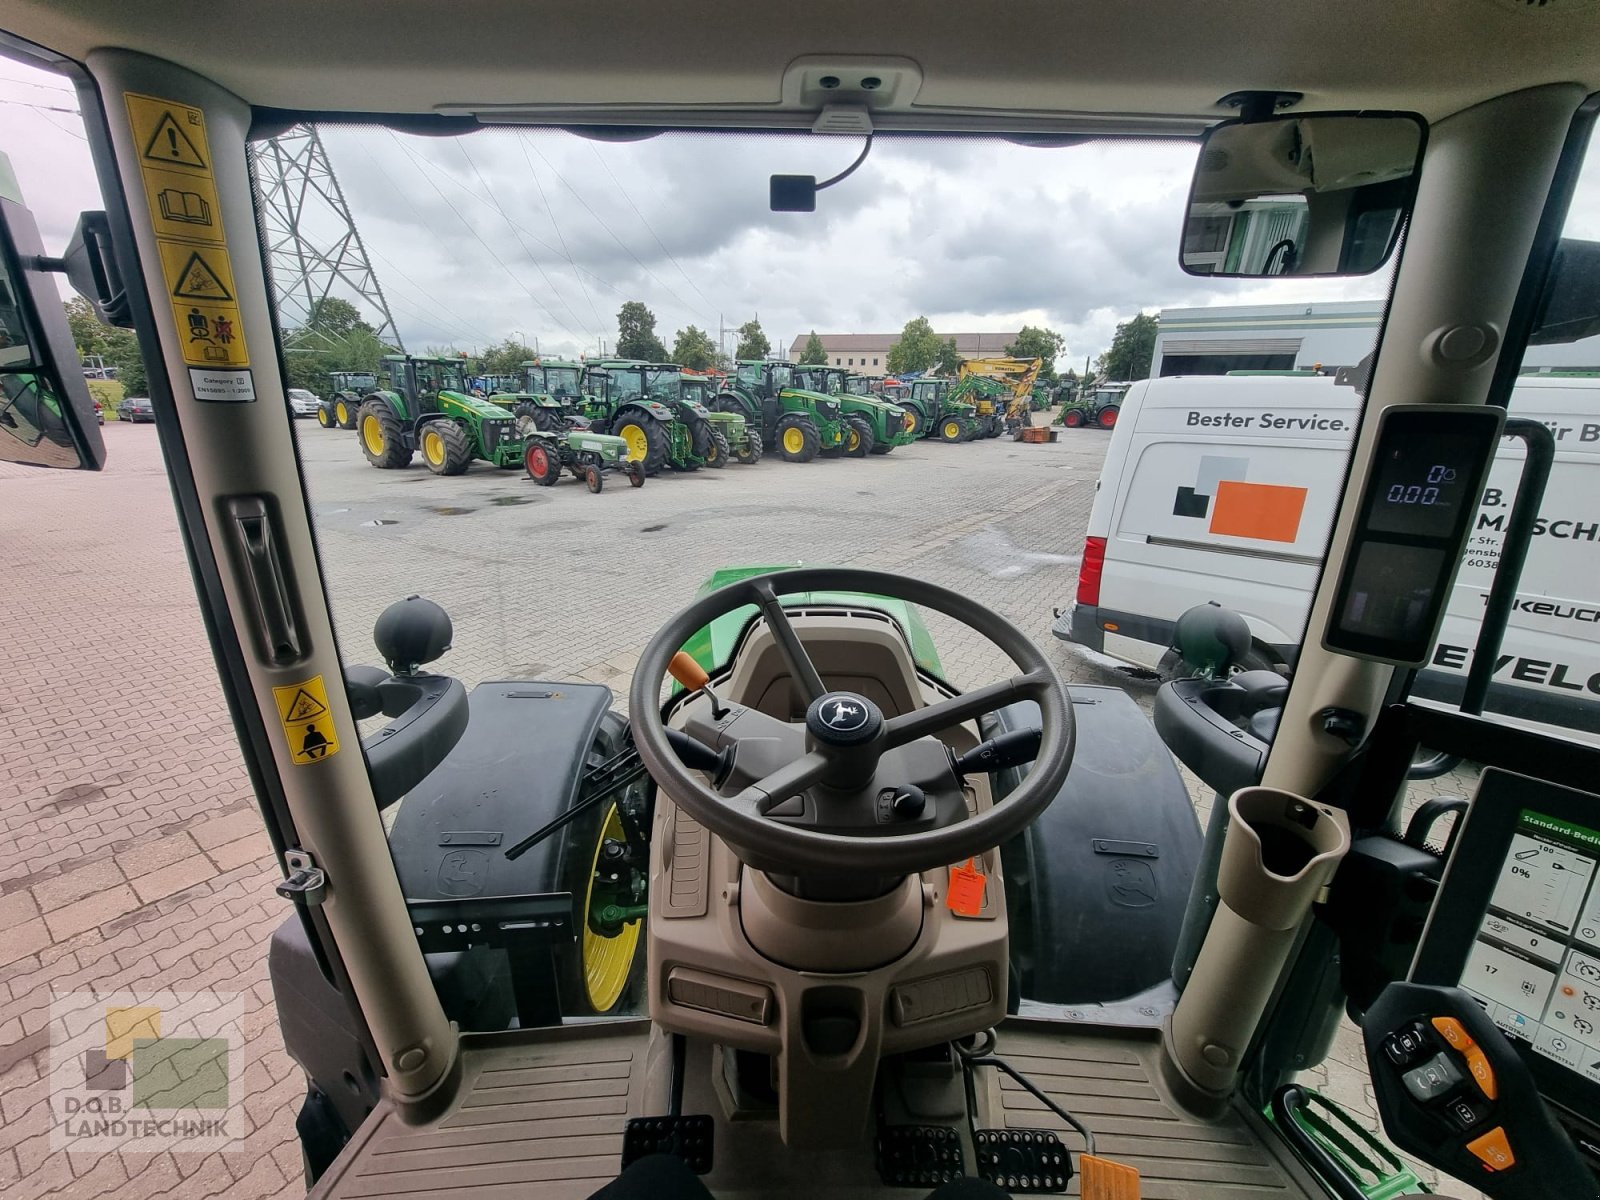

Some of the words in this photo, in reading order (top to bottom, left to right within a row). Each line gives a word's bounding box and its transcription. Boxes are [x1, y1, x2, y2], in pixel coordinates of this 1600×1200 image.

[1186, 411, 1255, 428] Bester
[1258, 412, 1350, 431] Service.
[1387, 484, 1439, 505] 0.00
[1476, 513, 1600, 542] MSCH
[1539, 844, 1554, 854] 100
[1511, 866, 1530, 879] 0%
[1530, 938, 1538, 947] 0
[1485, 964, 1498, 975] 17
[1496, 1020, 1531, 1039] AUTOTRAC
[1403, 1038, 1412, 1048] B
[1427, 1072, 1438, 1082] A
